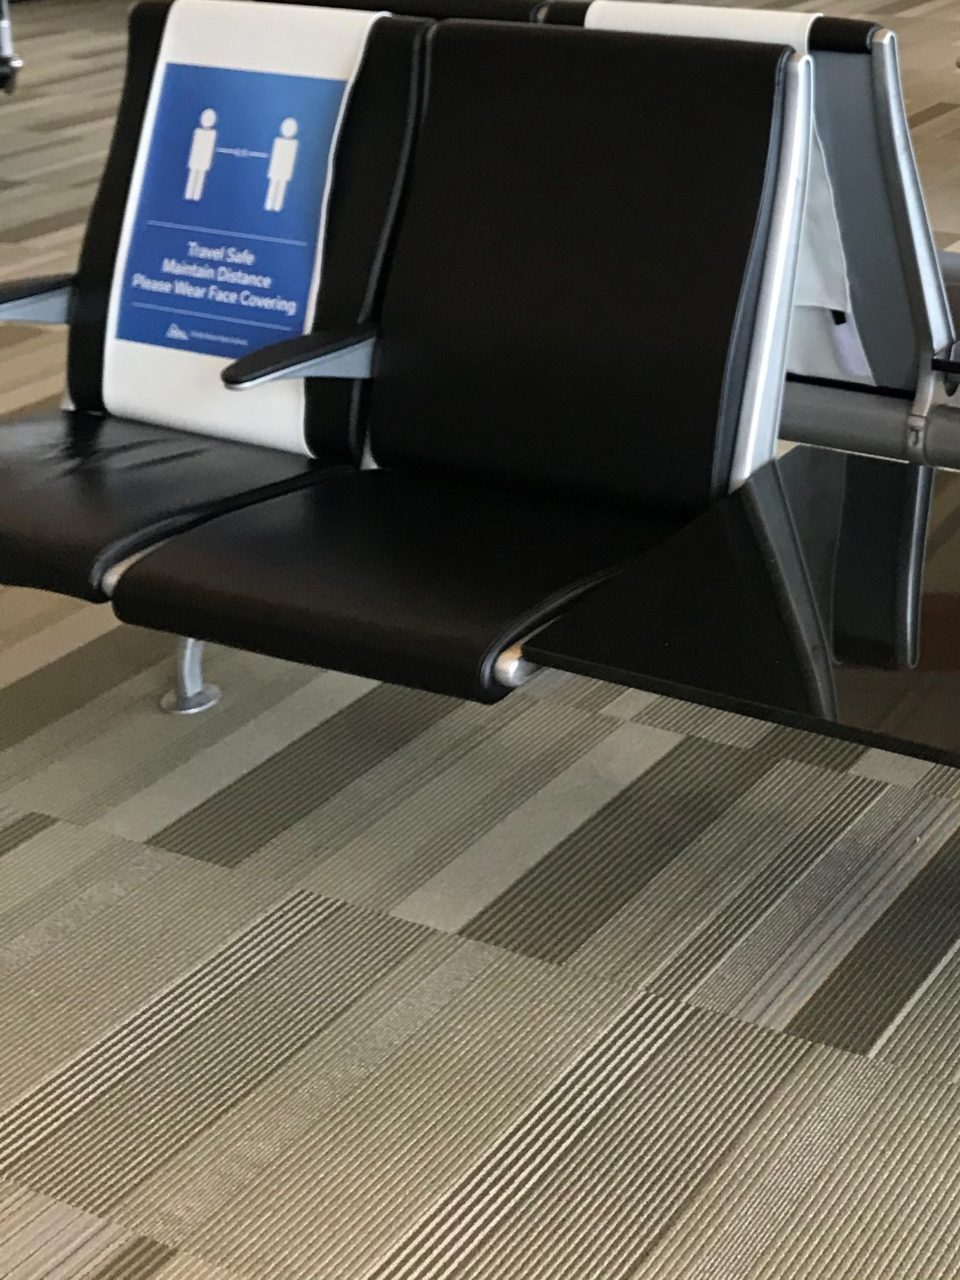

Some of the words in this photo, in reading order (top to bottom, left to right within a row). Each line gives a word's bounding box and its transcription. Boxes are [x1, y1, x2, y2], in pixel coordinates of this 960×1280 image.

[187, 241, 226, 261] Travel
[225, 246, 256, 266] Safe
[162, 257, 215, 280] Maintain
[216, 265, 273, 289] Distance
[131, 272, 173, 294] Please
[173, 279, 207, 299] Wear
[207, 284, 239, 305] Face
[239, 289, 298, 317] Covering
